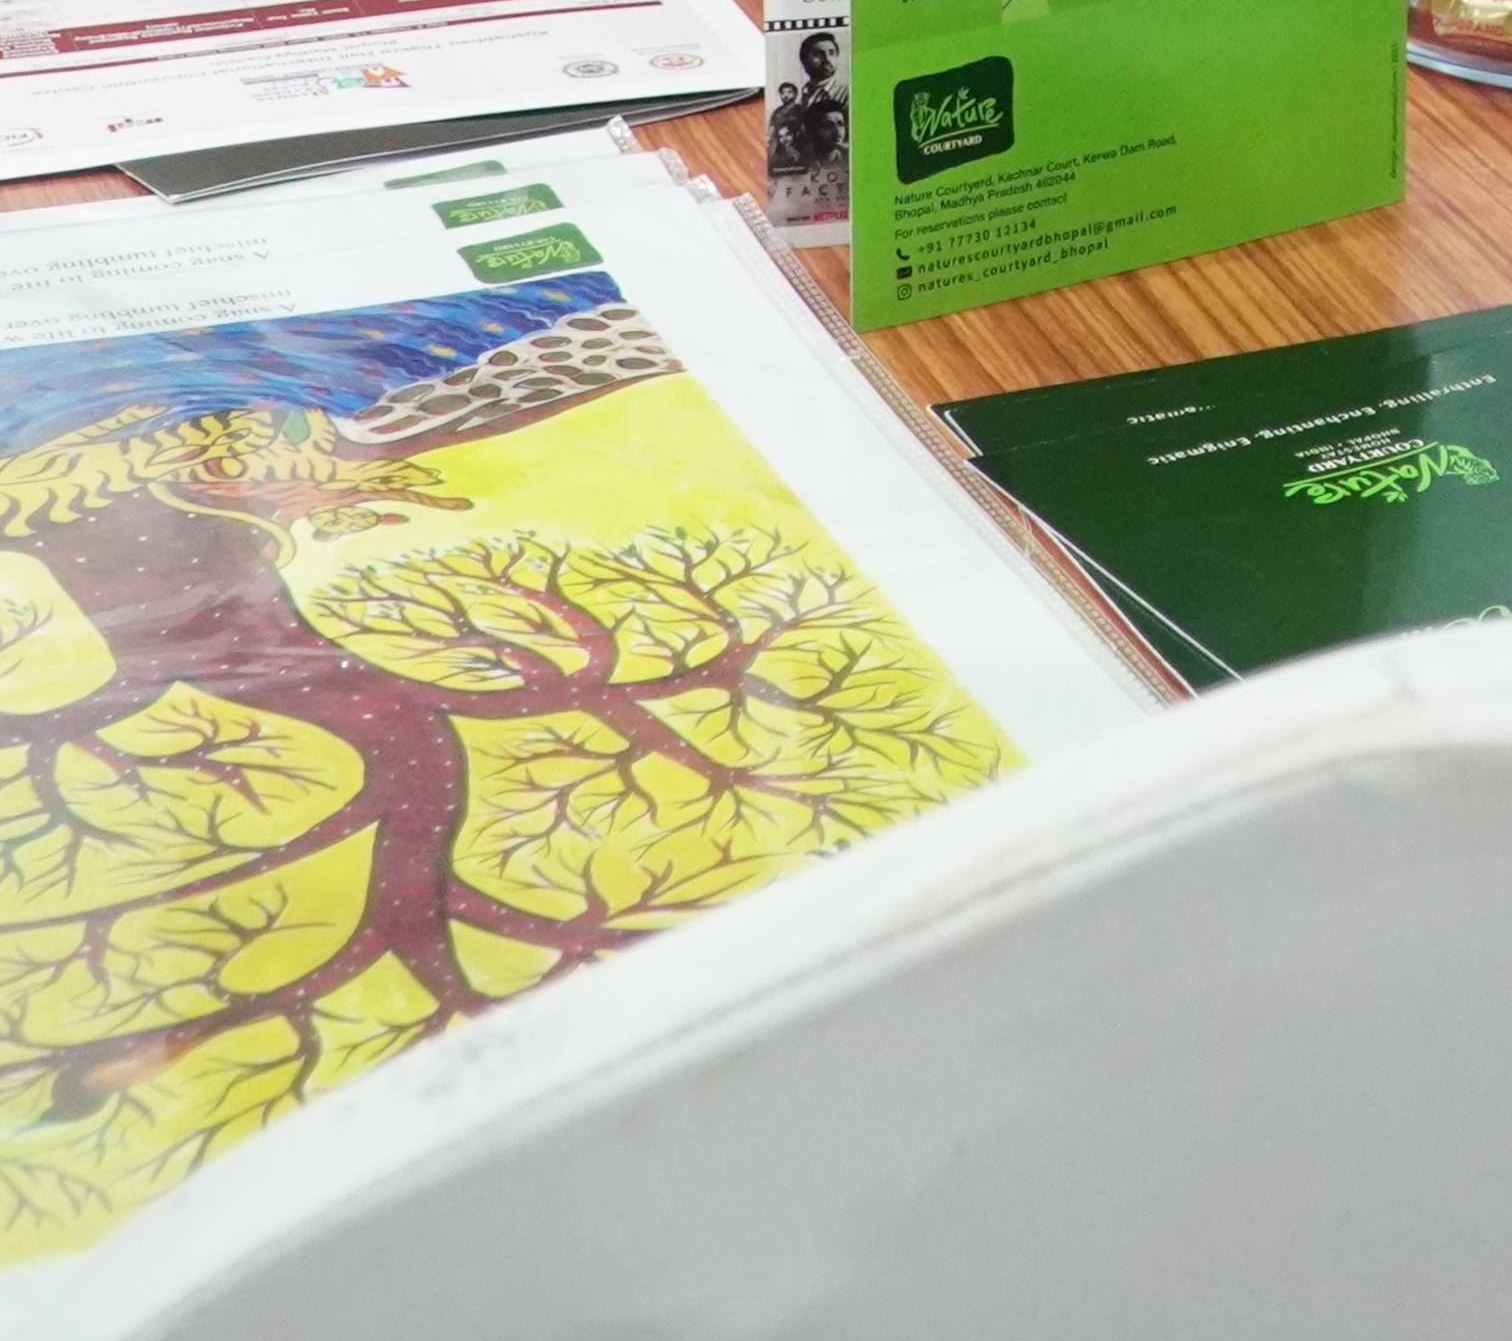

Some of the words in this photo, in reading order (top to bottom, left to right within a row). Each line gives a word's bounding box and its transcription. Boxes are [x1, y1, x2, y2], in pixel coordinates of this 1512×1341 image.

[918, 86, 1004, 144] Nature
[924, 135, 983, 155] COURTYARD
[940, 193, 985, 211] Madhya
[988, 182, 1032, 200] Pradesh
[893, 228, 914, 240] For
[988, 204, 1024, 221] please
[1027, 194, 1068, 212] contact
[918, 240, 943, 256] +91
[1145, 433, 1252, 466] Enigmatic
[1307, 437, 1425, 474] COURTYARD
[1319, 436, 1392, 459] HOMESTAY
[1284, 445, 1447, 506] Nature
